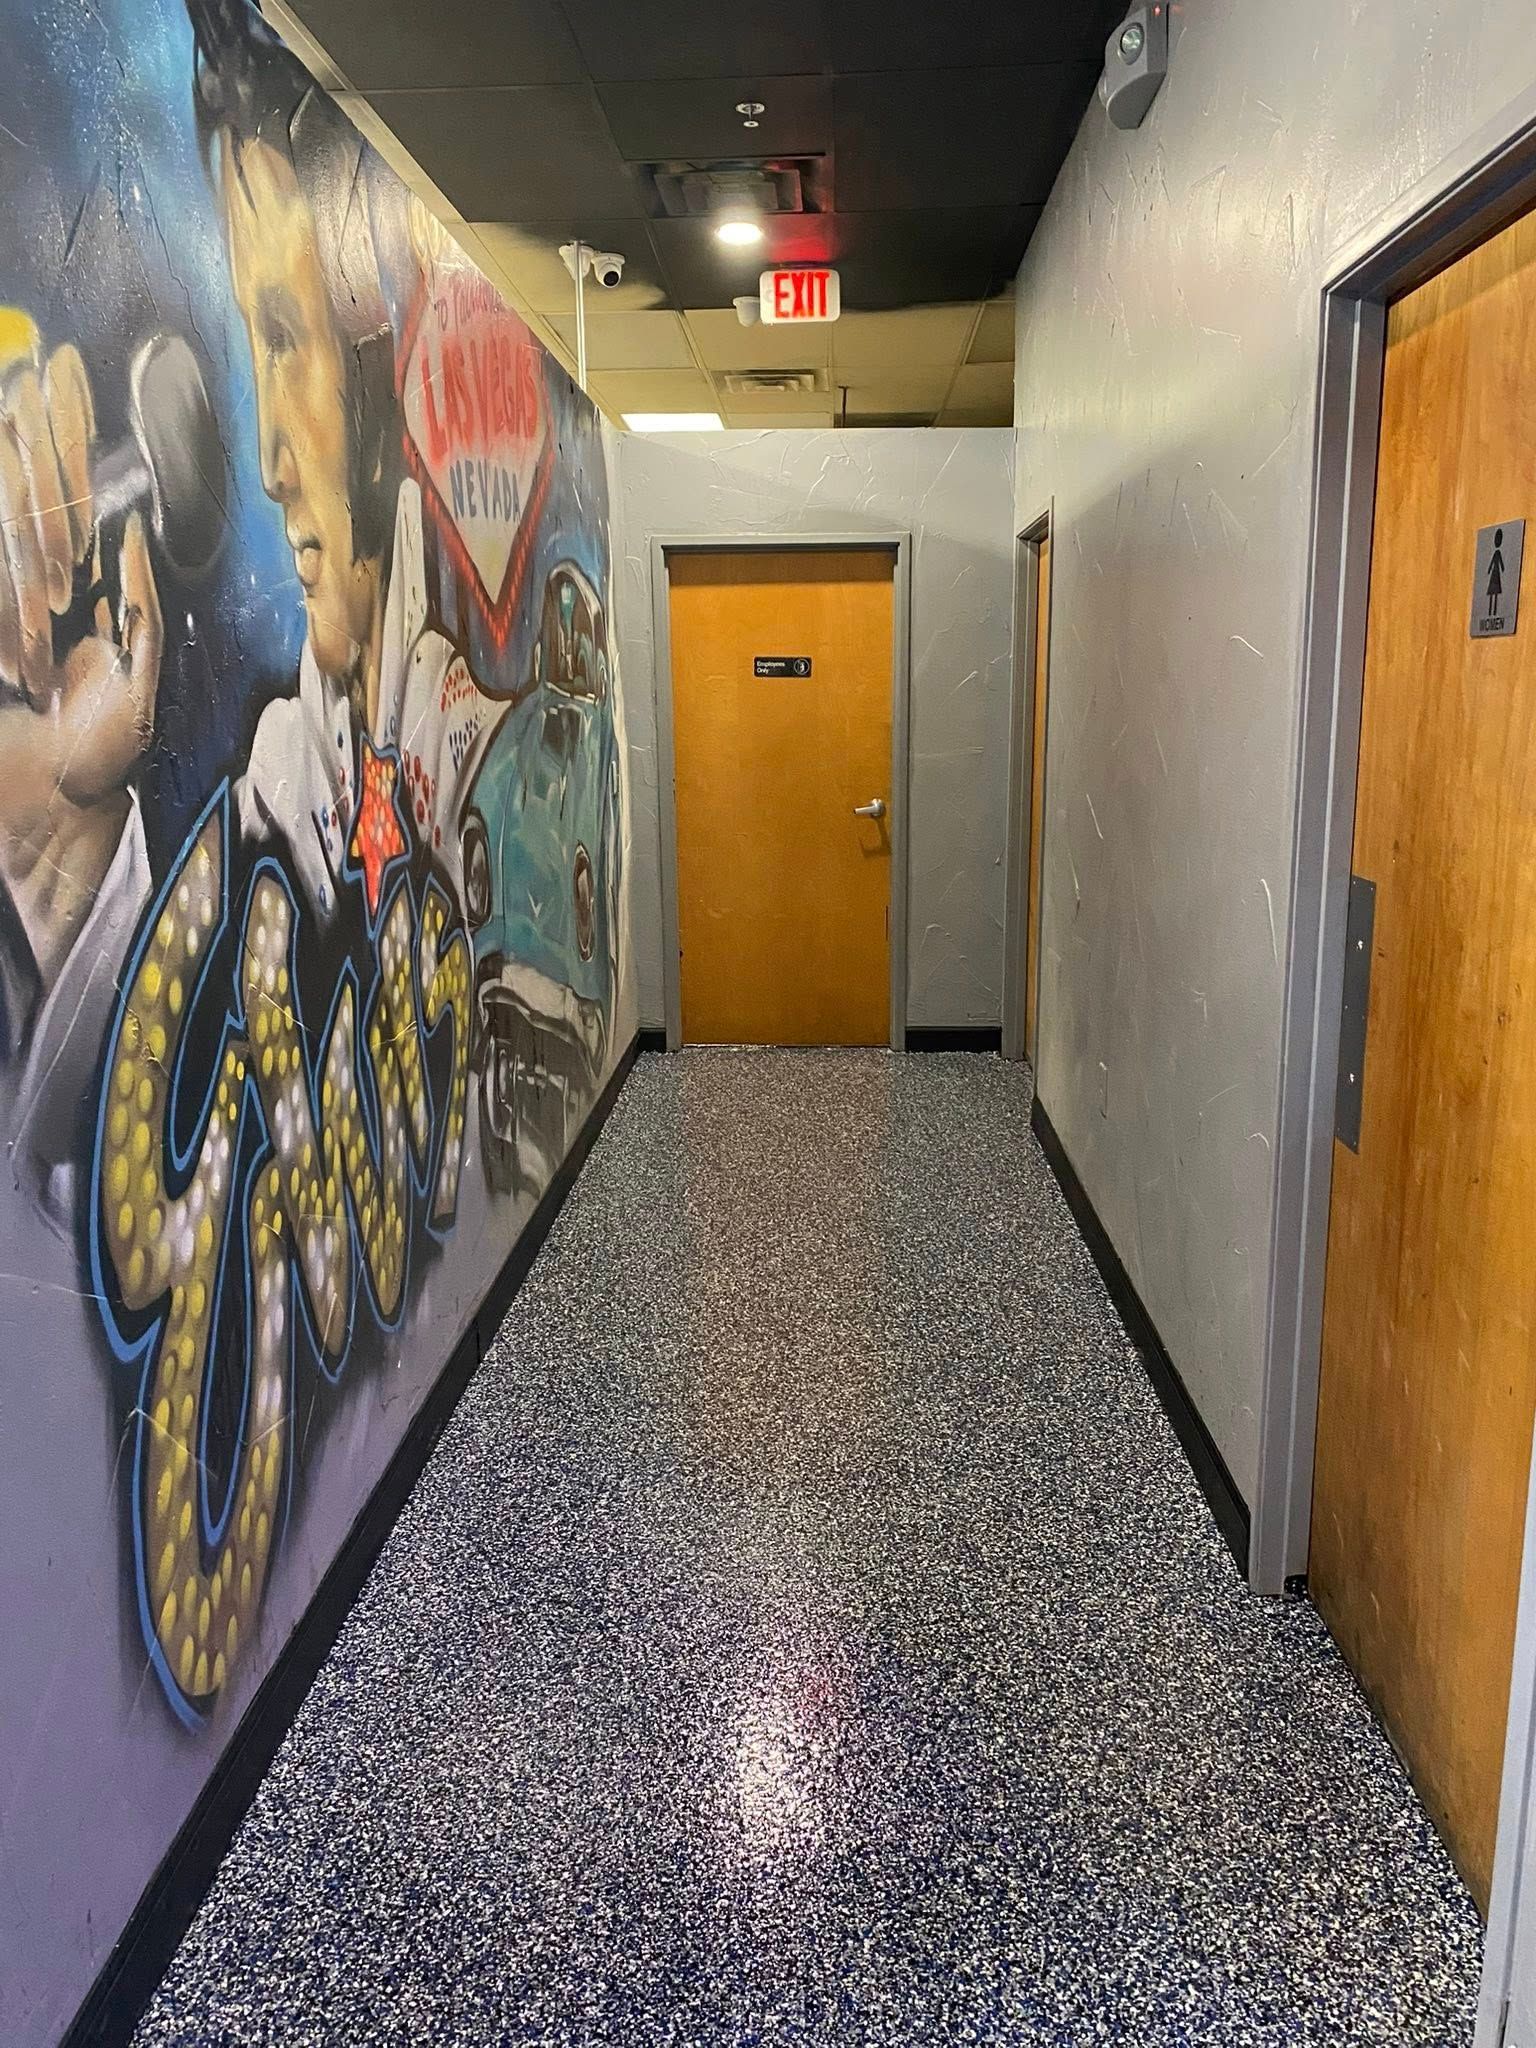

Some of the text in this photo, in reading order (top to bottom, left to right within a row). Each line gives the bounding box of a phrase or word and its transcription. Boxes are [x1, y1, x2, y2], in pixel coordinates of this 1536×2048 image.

[773, 271, 831, 318] EXIT
[419, 332, 539, 469] LAS VEGAS
[449, 458, 521, 524] NEVADA
[1479, 617, 1505, 632] WOMEN
[756, 660, 786, 668] Employees
[756, 667, 769, 675] Only
